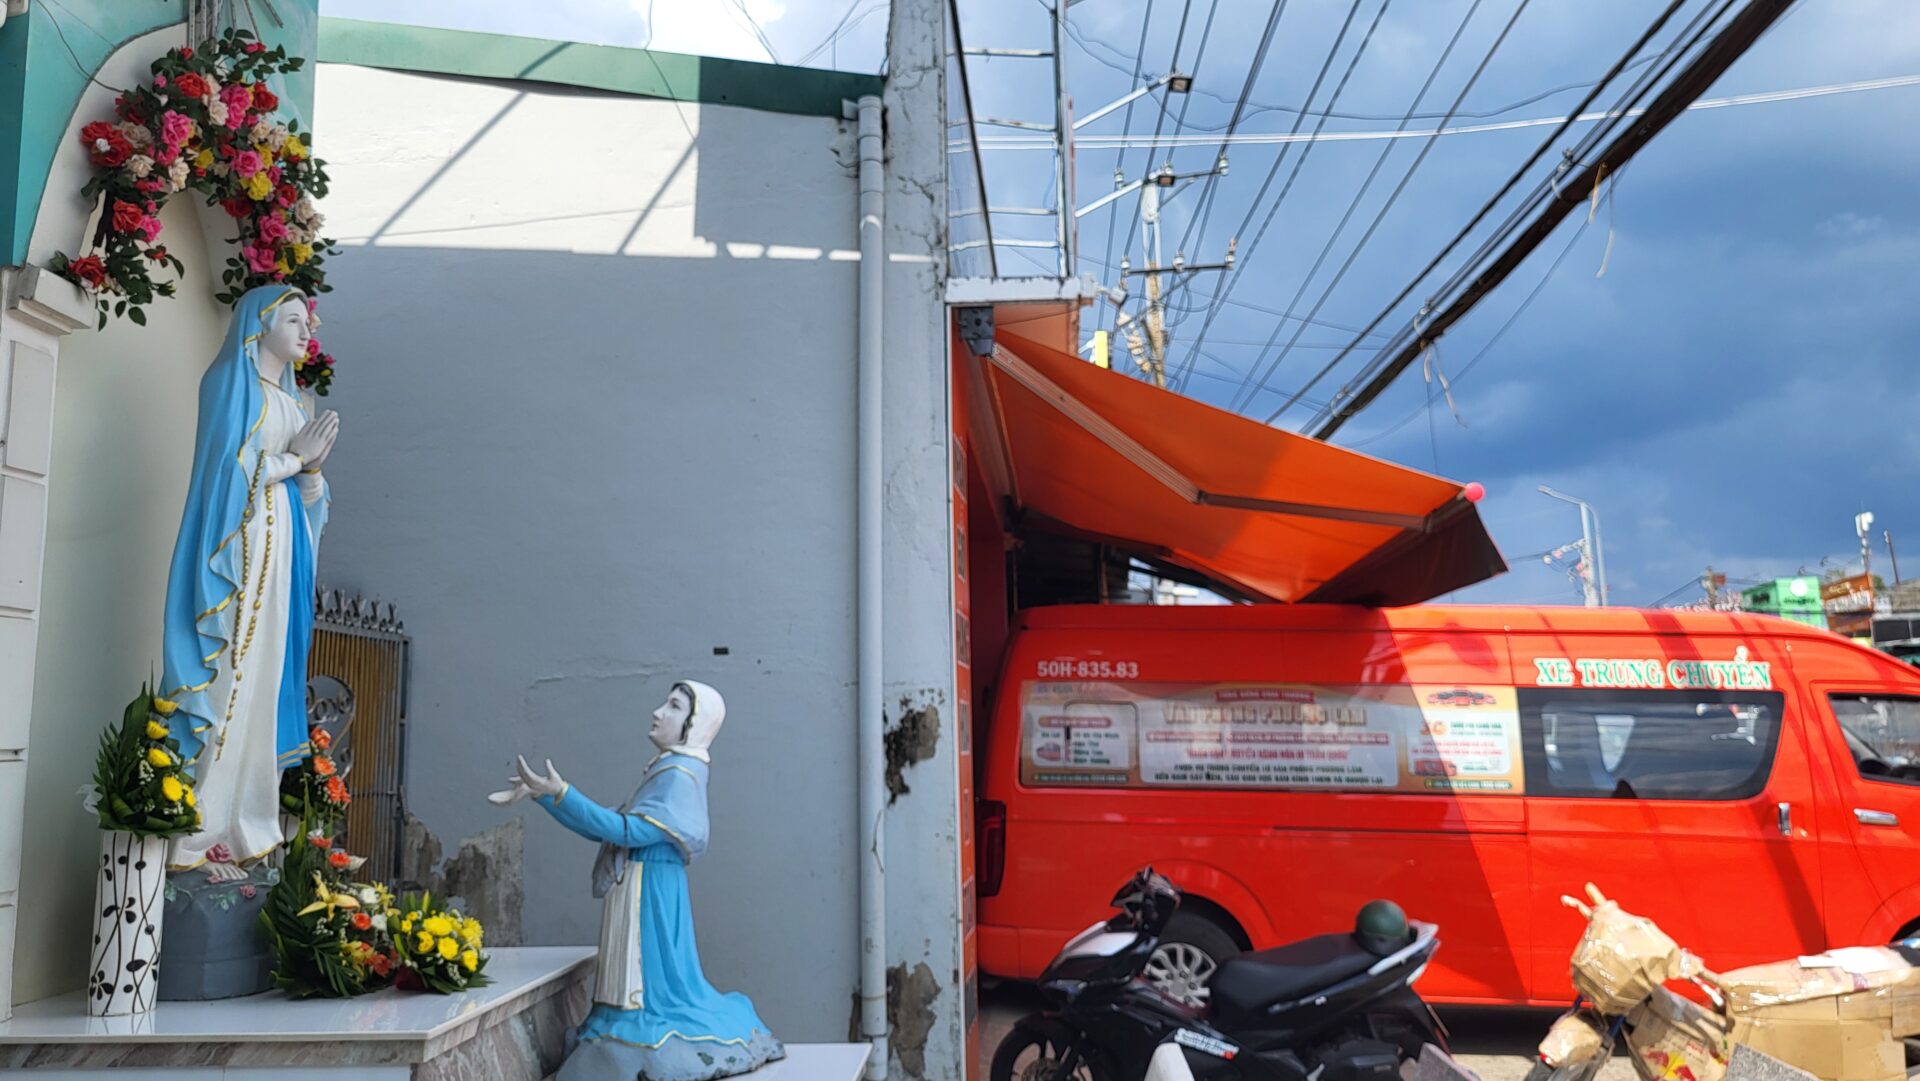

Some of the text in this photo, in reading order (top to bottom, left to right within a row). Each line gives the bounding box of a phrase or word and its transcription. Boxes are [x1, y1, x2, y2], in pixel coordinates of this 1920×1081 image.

[1534, 646, 1772, 689] XE TRUNG CHUYỂN
